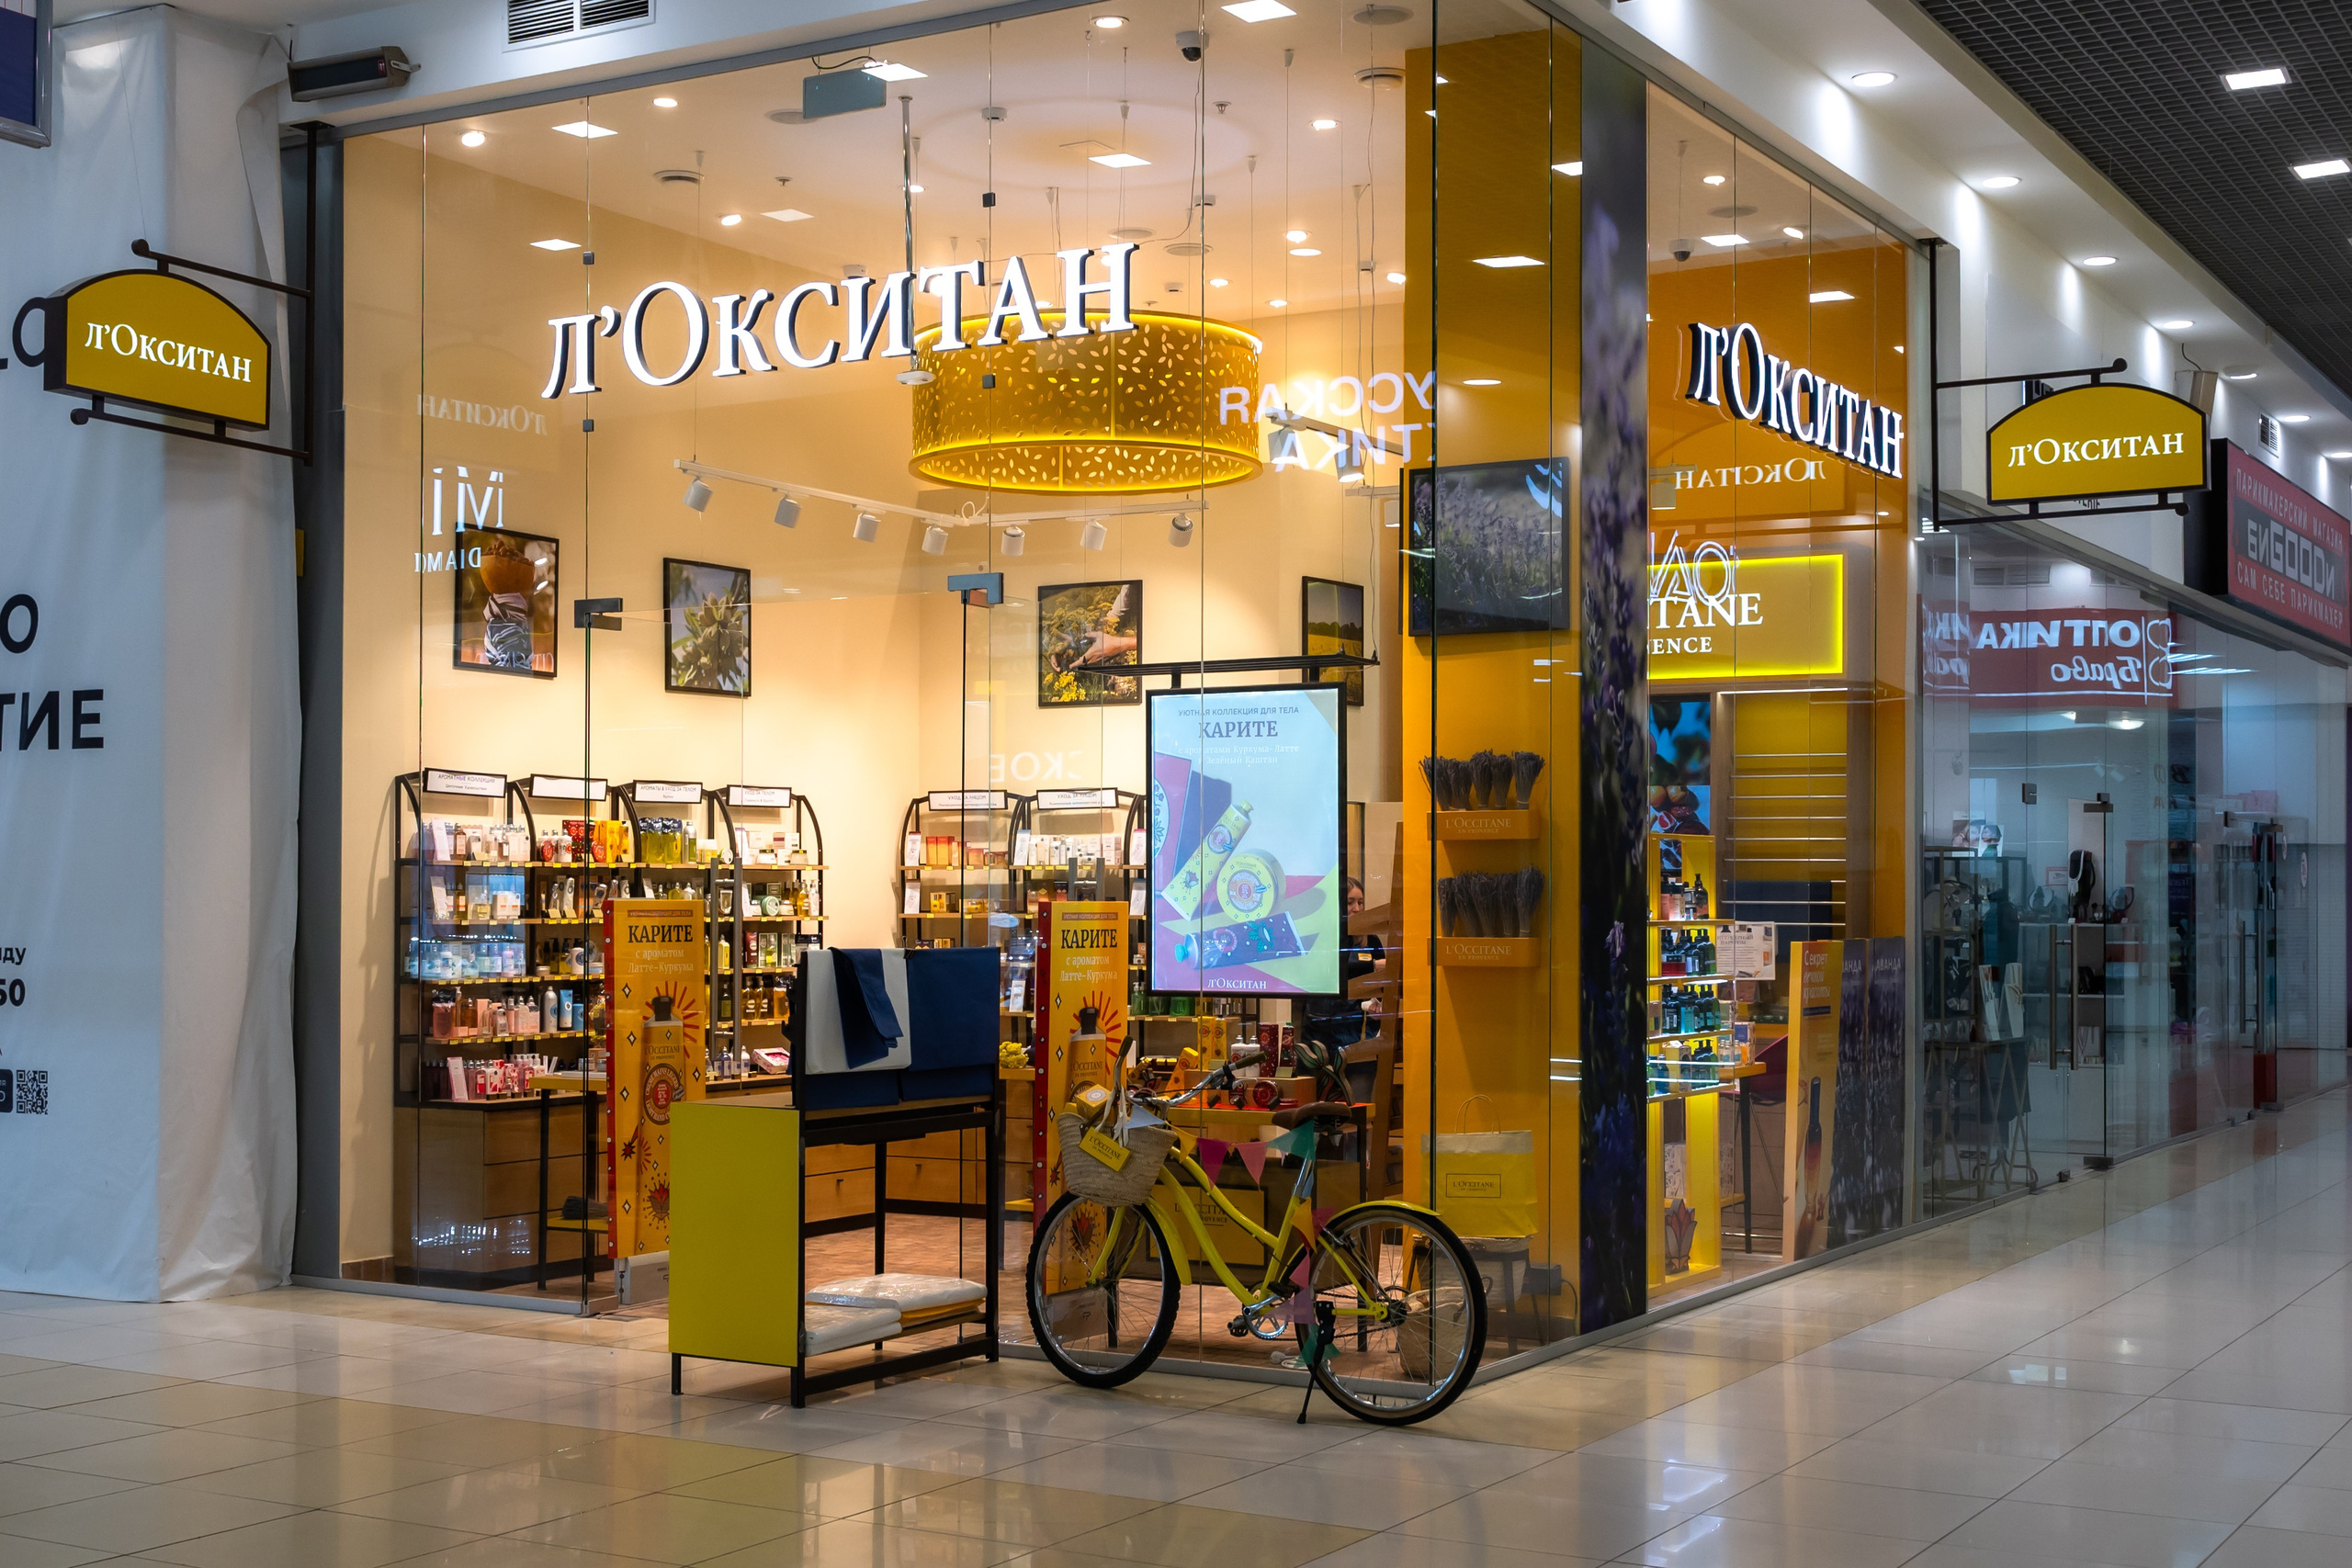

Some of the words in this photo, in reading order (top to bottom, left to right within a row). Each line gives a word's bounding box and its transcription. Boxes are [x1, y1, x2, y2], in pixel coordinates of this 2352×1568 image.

[2236, 468, 2307, 530] ПАРИКМАХЕРСКИЙ
[2313, 516, 2343, 552] МАГАЗИН
[2237, 560, 2257, 591] САМ
[2262, 574, 2286, 604] СЕБЕ
[2291, 588, 2343, 630] ПАРИКМАХЕР
[1647, 592, 1763, 629] TANE
[1646, 636, 1713, 655] ENCE
[1213, 707, 1259, 716] КОЛЛЕКЦИЯ
[1260, 706, 1276, 715] ДЛЯ
[1279, 706, 1300, 715] ТЕЛА
[1198, 720, 1279, 739] КАРИТЕ
[1444, 817, 1512, 829] L'OCCITANE
[628, 924, 694, 943] КАРИТЕ
[1061, 929, 1118, 949] КАРИТЕ
[0, 947, 27, 965] ду
[643, 949, 684, 961] ароматом
[1445, 943, 1512, 955] L'OCCITANE
[628, 962, 694, 975] Латте-Куркума
[1072, 955, 1110, 969] ароматом
[1060, 969, 1118, 984] Латте-Куркума
[1089, 1135, 1121, 1160] L'OCCITANE
[1201, 1215, 1227, 1224] OVENCE
